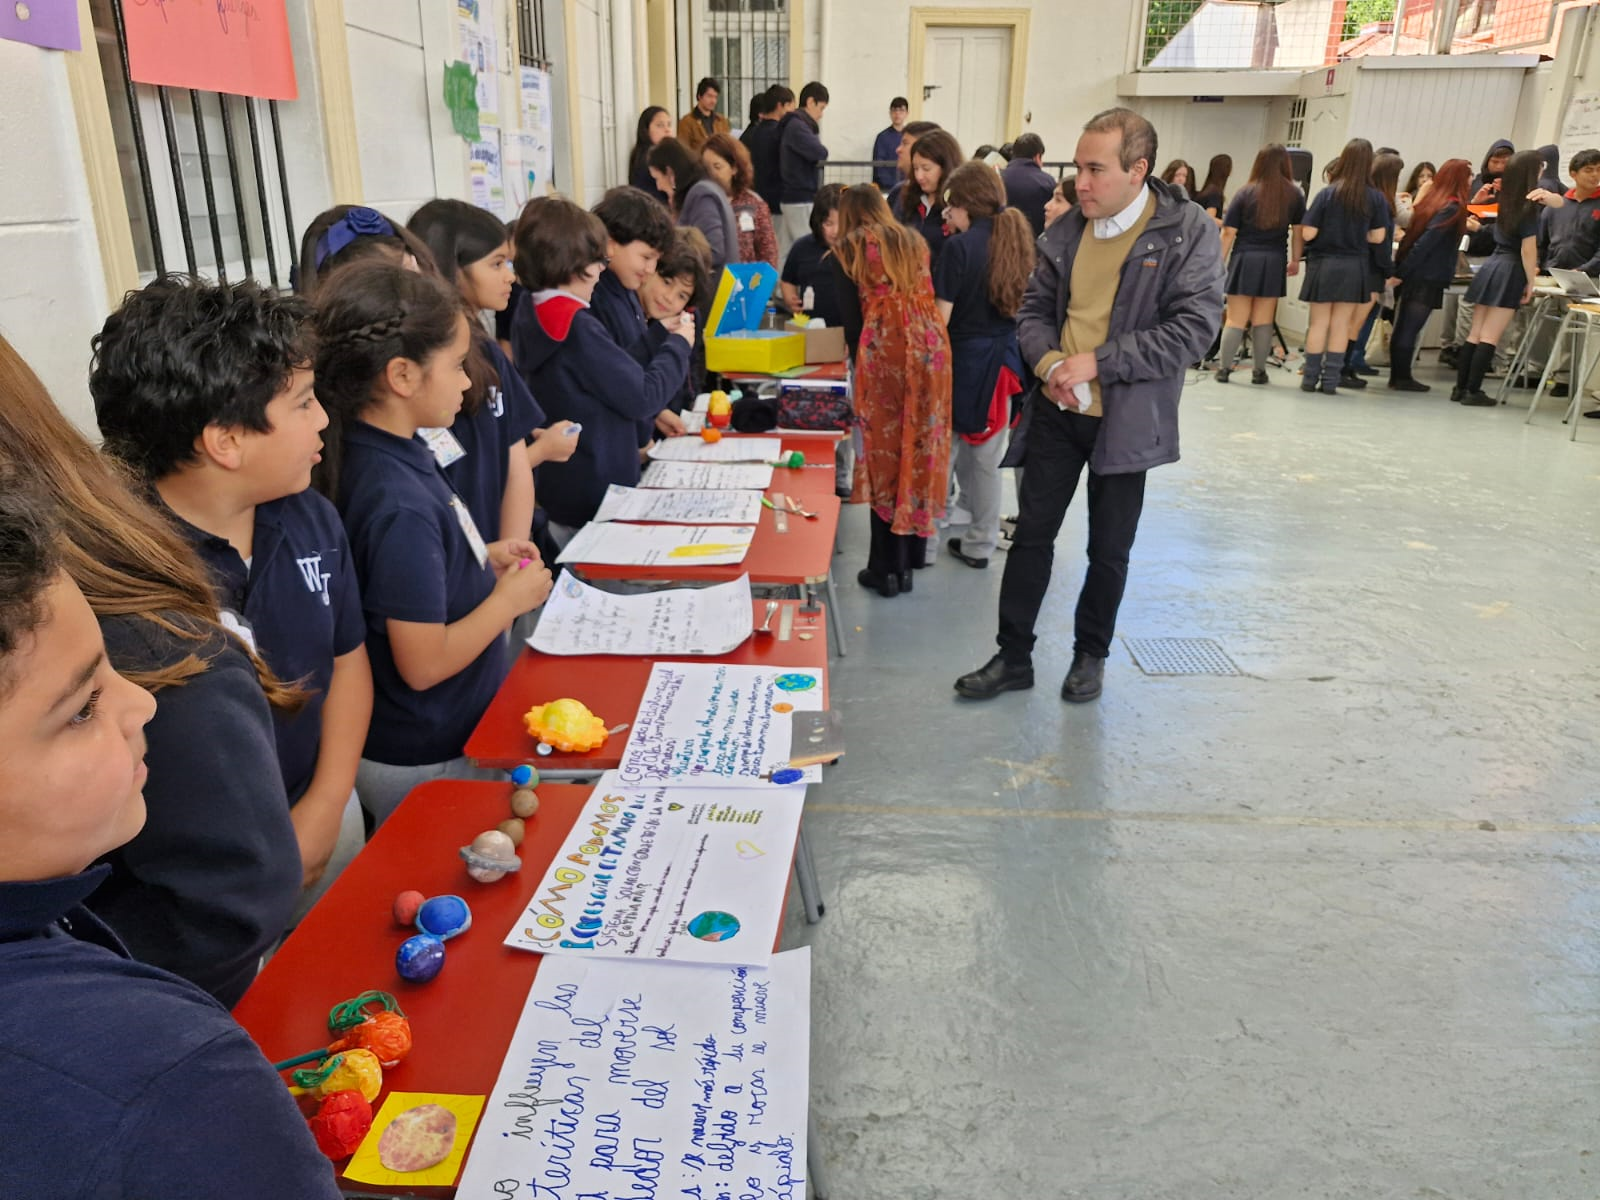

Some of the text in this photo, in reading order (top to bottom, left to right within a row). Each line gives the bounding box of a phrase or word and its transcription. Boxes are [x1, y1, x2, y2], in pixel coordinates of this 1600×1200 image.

[534, 983, 578, 1018] las
[569, 1014, 610, 1048] del
[608, 993, 641, 1084] moverse
[641, 1023, 678, 1052] sol
[721, 1042, 744, 1063] su
[630, 1080, 671, 1109] del
[589, 1109, 642, 1171] para
